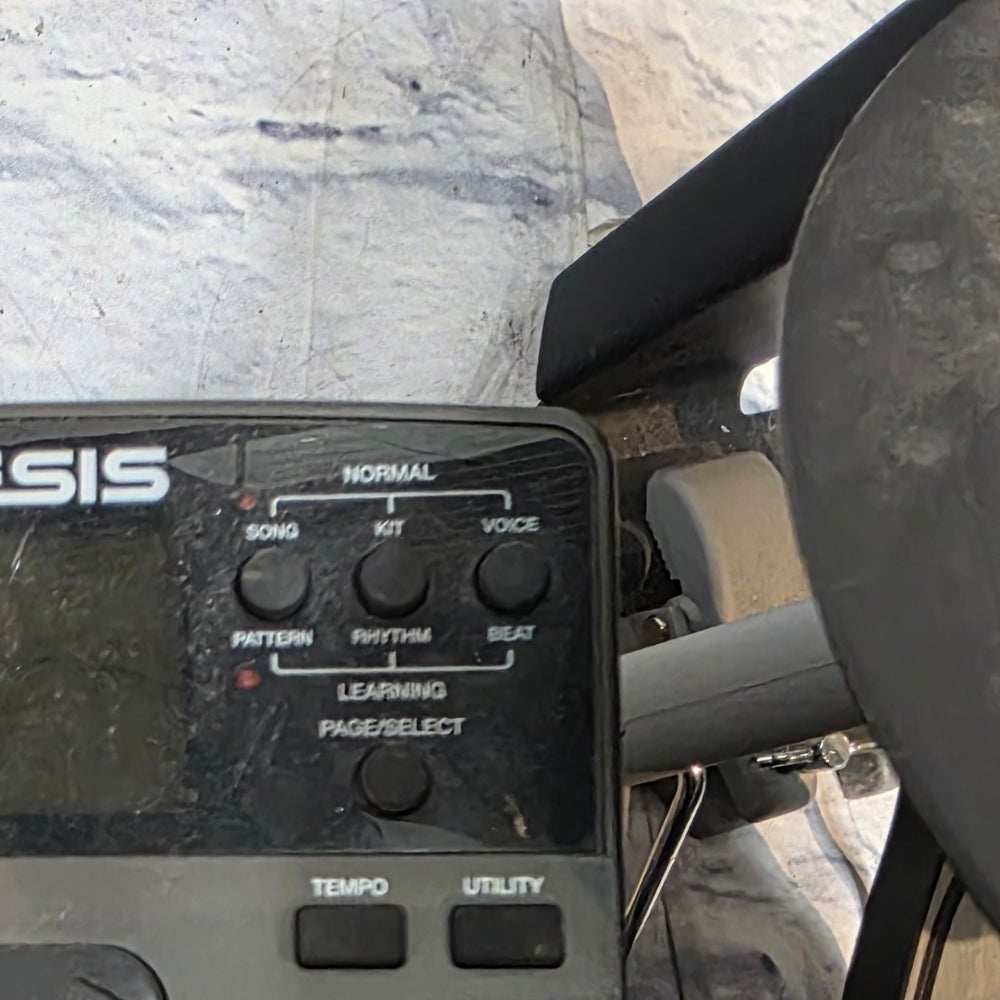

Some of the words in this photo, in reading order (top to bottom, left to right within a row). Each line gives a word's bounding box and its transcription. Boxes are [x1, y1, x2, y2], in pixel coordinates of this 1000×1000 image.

[343, 463, 436, 483] NORMAL
[245, 521, 299, 540] SONG
[374, 519, 403, 537] KIT
[481, 516, 540, 534] VOICE
[231, 628, 313, 648] PATTERN
[351, 627, 431, 645] RHYTHM
[487, 624, 535, 642] BEAT
[337, 681, 447, 701] LEARNING
[318, 716, 466, 737] PAGE/SELECT
[311, 876, 389, 897] TEMPO
[462, 876, 545, 896] UTILITY
